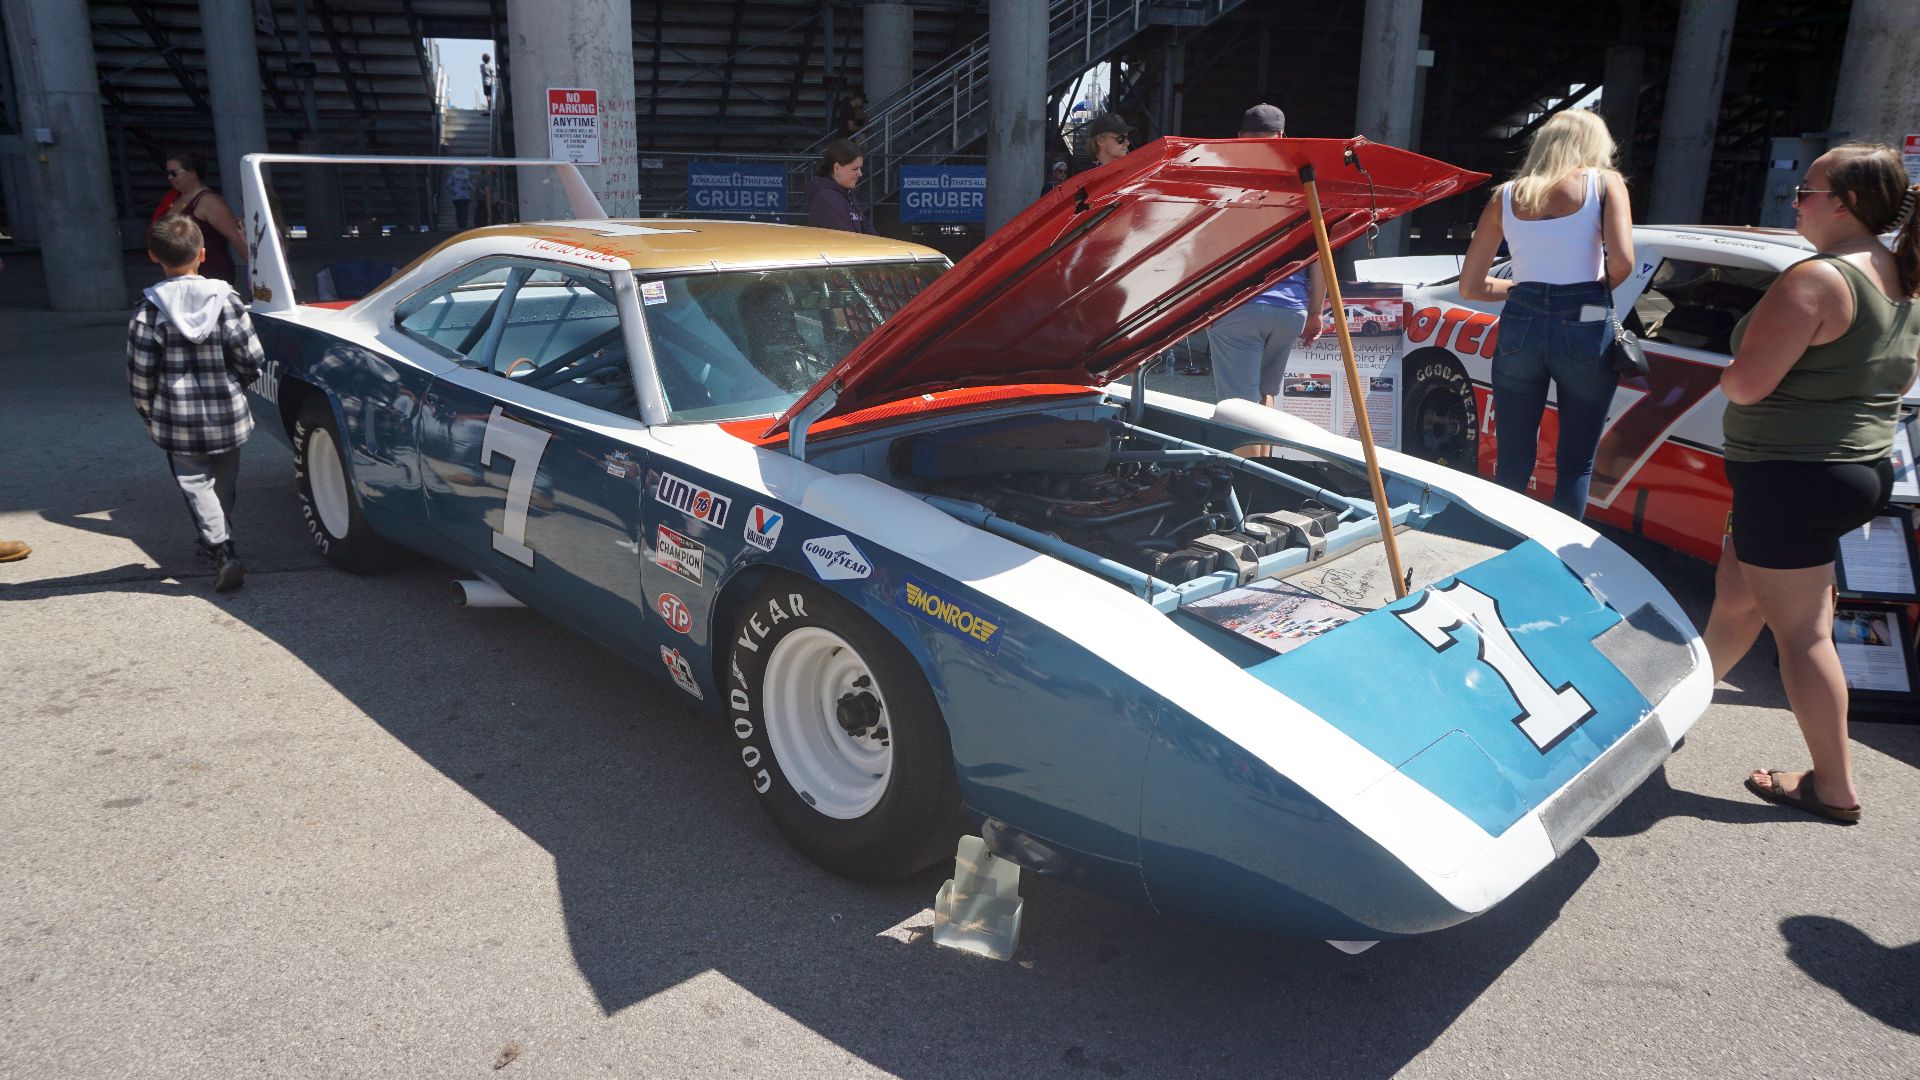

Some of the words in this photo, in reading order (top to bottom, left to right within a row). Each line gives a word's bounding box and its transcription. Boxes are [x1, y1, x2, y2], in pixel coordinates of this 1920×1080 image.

[552, 103, 595, 114] PARKING
[566, 92, 580, 103] NO
[553, 117, 596, 127] ANYTIME
[695, 190, 779, 207] GRUBER
[906, 192, 983, 208] GRUBER
[1351, 343, 1394, 354] ulwicki
[1379, 353, 1392, 363] #7
[294, 419, 306, 478] YEAR
[480, 403, 553, 569] 7
[697, 498, 708, 512] 76
[747, 527, 774, 550] VALVOLINE
[659, 540, 700, 570] CHAMPION
[805, 542, 832, 560] GOOD
[838, 557, 867, 575] YEAR
[661, 598, 689, 627] STP
[738, 593, 808, 653] YEAR
[912, 588, 983, 639] MONROE
[1391, 577, 1598, 755] 7
[730, 688, 772, 794] GOOD
